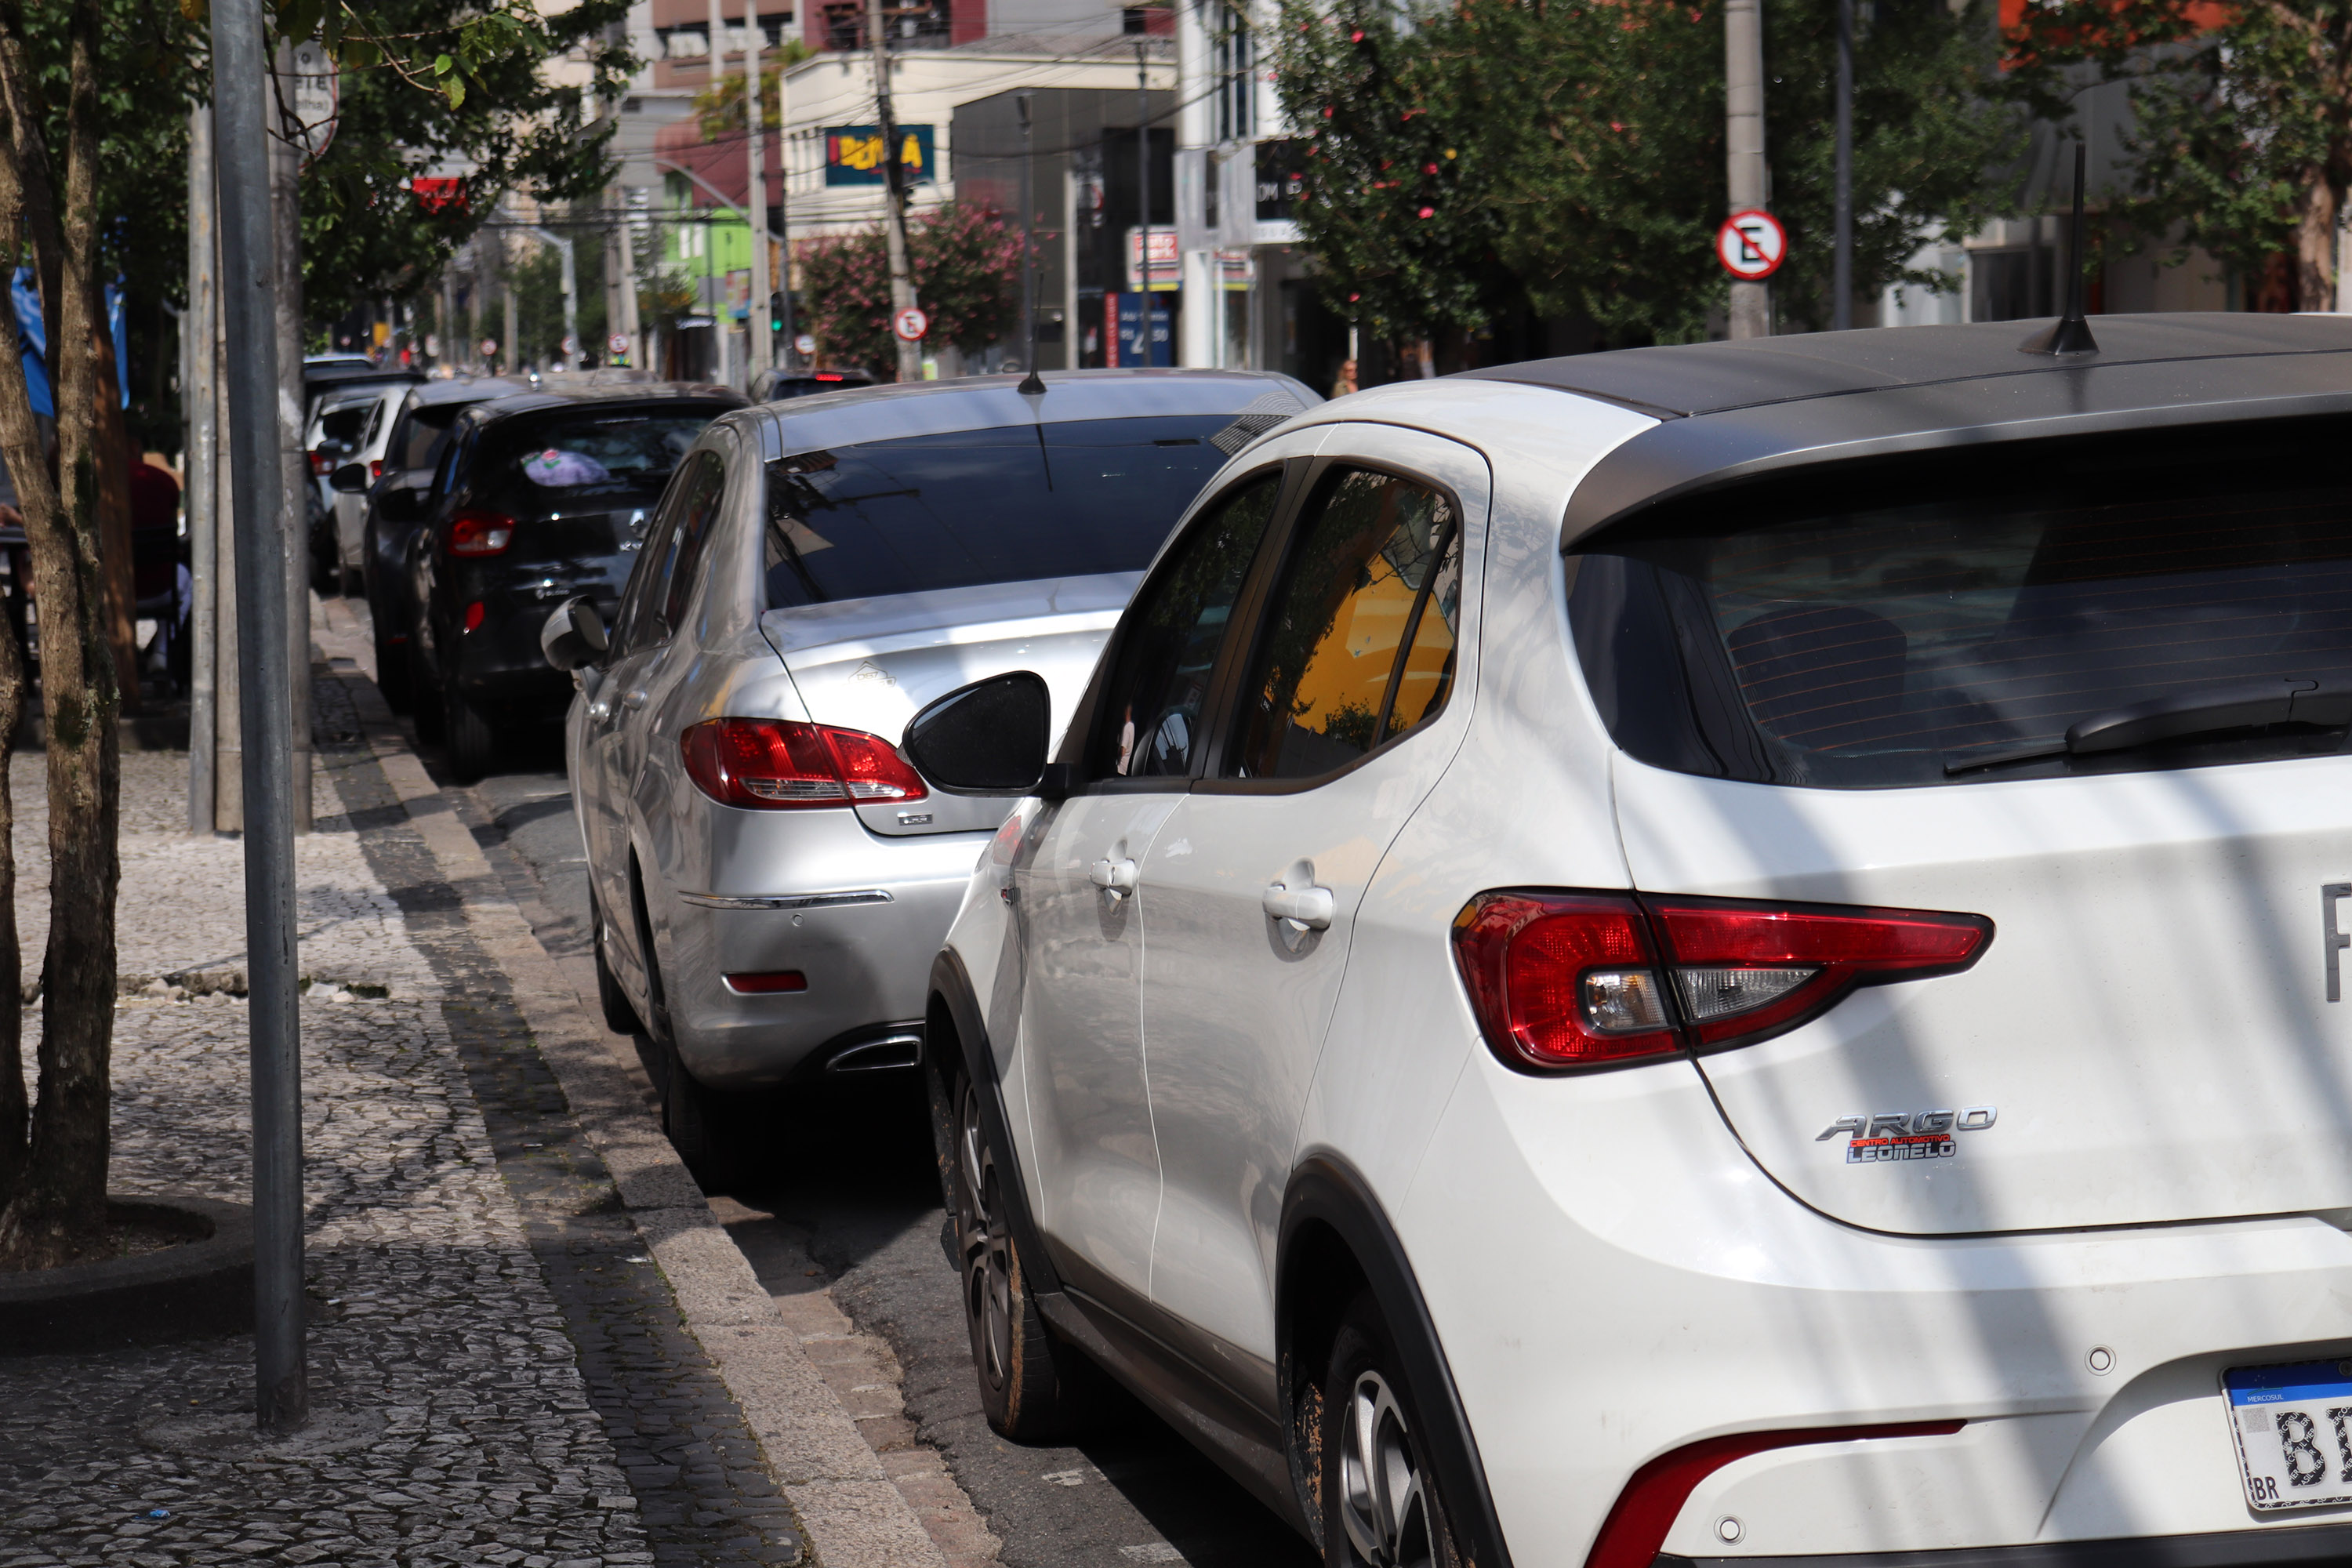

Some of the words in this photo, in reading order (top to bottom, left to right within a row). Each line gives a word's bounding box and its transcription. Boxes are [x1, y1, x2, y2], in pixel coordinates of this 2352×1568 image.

[1815, 1106, 1998, 1142] ARGO
[1846, 1141, 1957, 1164] LEOMELO
[1850, 1138, 1889, 1148] CENTRO
[1890, 1134, 1951, 1145] AUTOMOTIVO
[2247, 1394, 2284, 1403] MERCOSUL
[2252, 1476, 2280, 1501] BR
